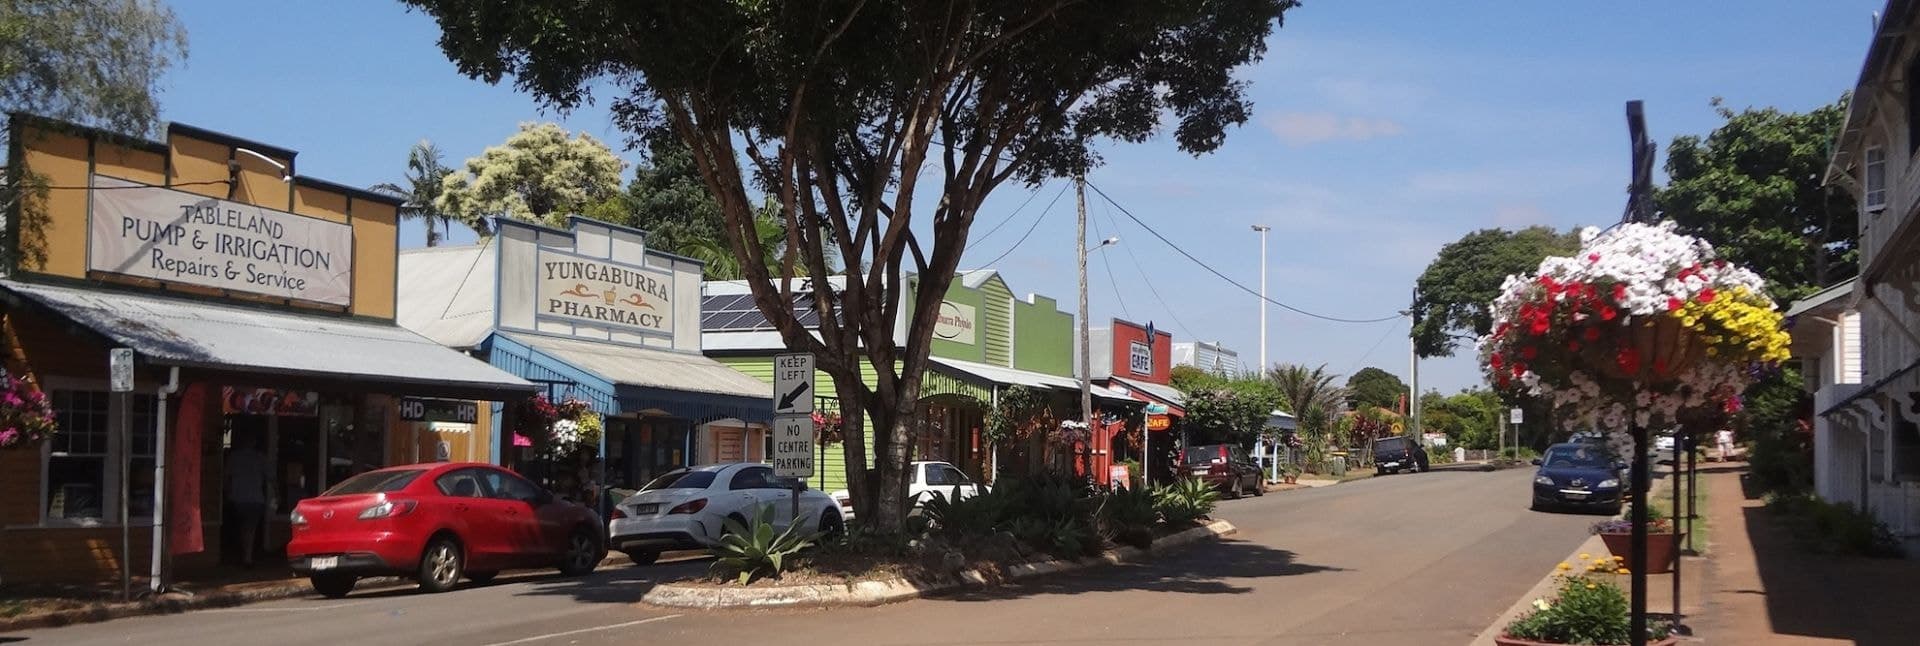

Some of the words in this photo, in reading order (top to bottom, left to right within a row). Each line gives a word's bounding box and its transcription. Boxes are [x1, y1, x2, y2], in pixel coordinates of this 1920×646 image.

[180, 204, 283, 240] TABLELAND
[122, 217, 185, 247] PUMP
[192, 230, 210, 250] &
[215, 235, 330, 271] IRRIGATION
[152, 248, 218, 280] Repairs
[225, 261, 241, 280] &
[246, 264, 306, 292] Service
[545, 262, 669, 302] YUNGABURRA
[549, 299, 663, 329] PHARMACY
[780, 358, 807, 369] KEEP
[781, 369, 806, 381] LEFT
[402, 401, 425, 418] HD
[457, 405, 476, 422] HR
[786, 424, 801, 436] NO
[778, 441, 809, 453] CENTRE
[776, 457, 812, 470] PARKING
